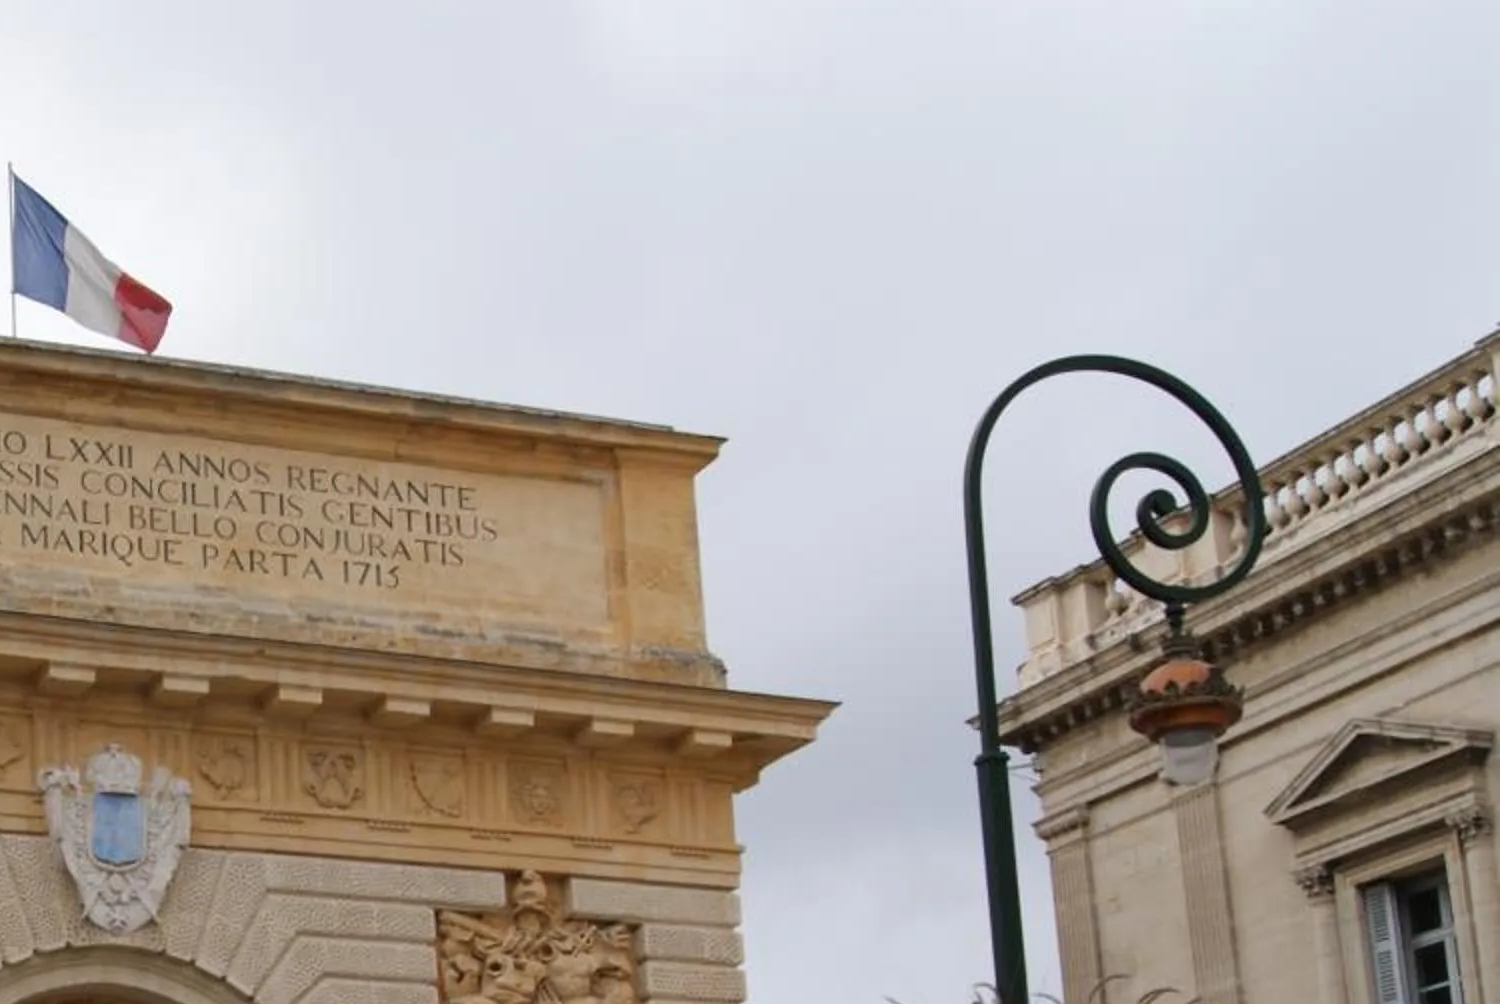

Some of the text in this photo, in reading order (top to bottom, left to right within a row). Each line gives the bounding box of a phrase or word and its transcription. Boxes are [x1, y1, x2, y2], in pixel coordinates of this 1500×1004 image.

[45, 434, 133, 468] LXXII
[154, 451, 270, 485] ANNOS
[288, 465, 477, 511] REGNANTE
[80, 470, 302, 518] CONCILIATIS
[322, 501, 498, 543] GENTIBUS
[21, 524, 184, 566] MARIQUE
[202, 544, 324, 582] PARTA
[342, 560, 400, 590] 1715
[129, 508, 237, 541] BELLO
[256, 521, 464, 567] CONJURATIS
